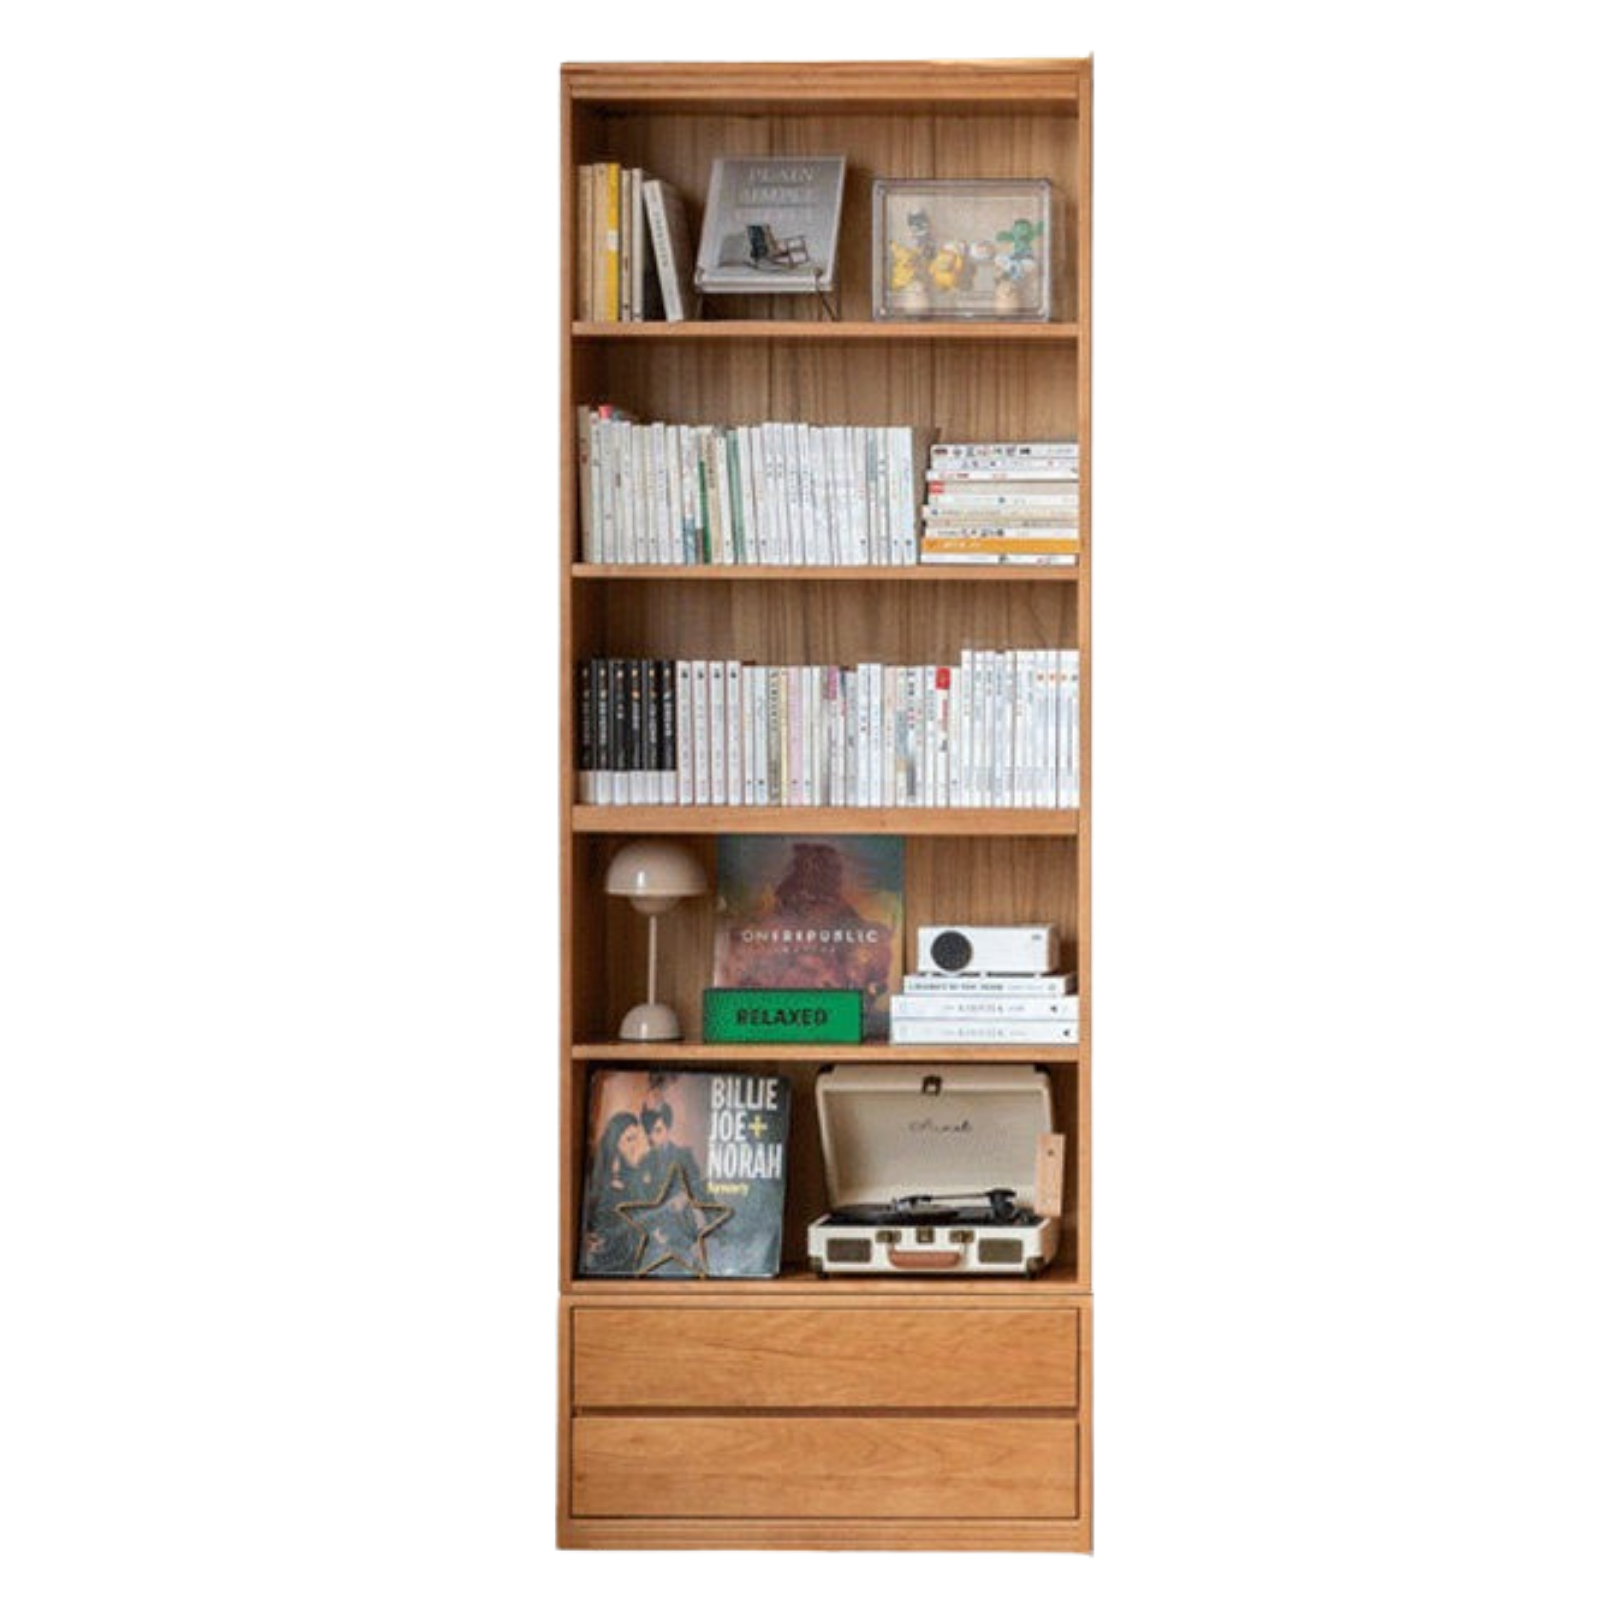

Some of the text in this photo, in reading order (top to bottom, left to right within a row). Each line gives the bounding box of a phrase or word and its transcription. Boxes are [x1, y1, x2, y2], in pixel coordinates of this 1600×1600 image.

[736, 1008, 828, 1027] RELAXED
[710, 1077, 778, 1110] BILLIE
[707, 1143, 782, 1179] NORAH
